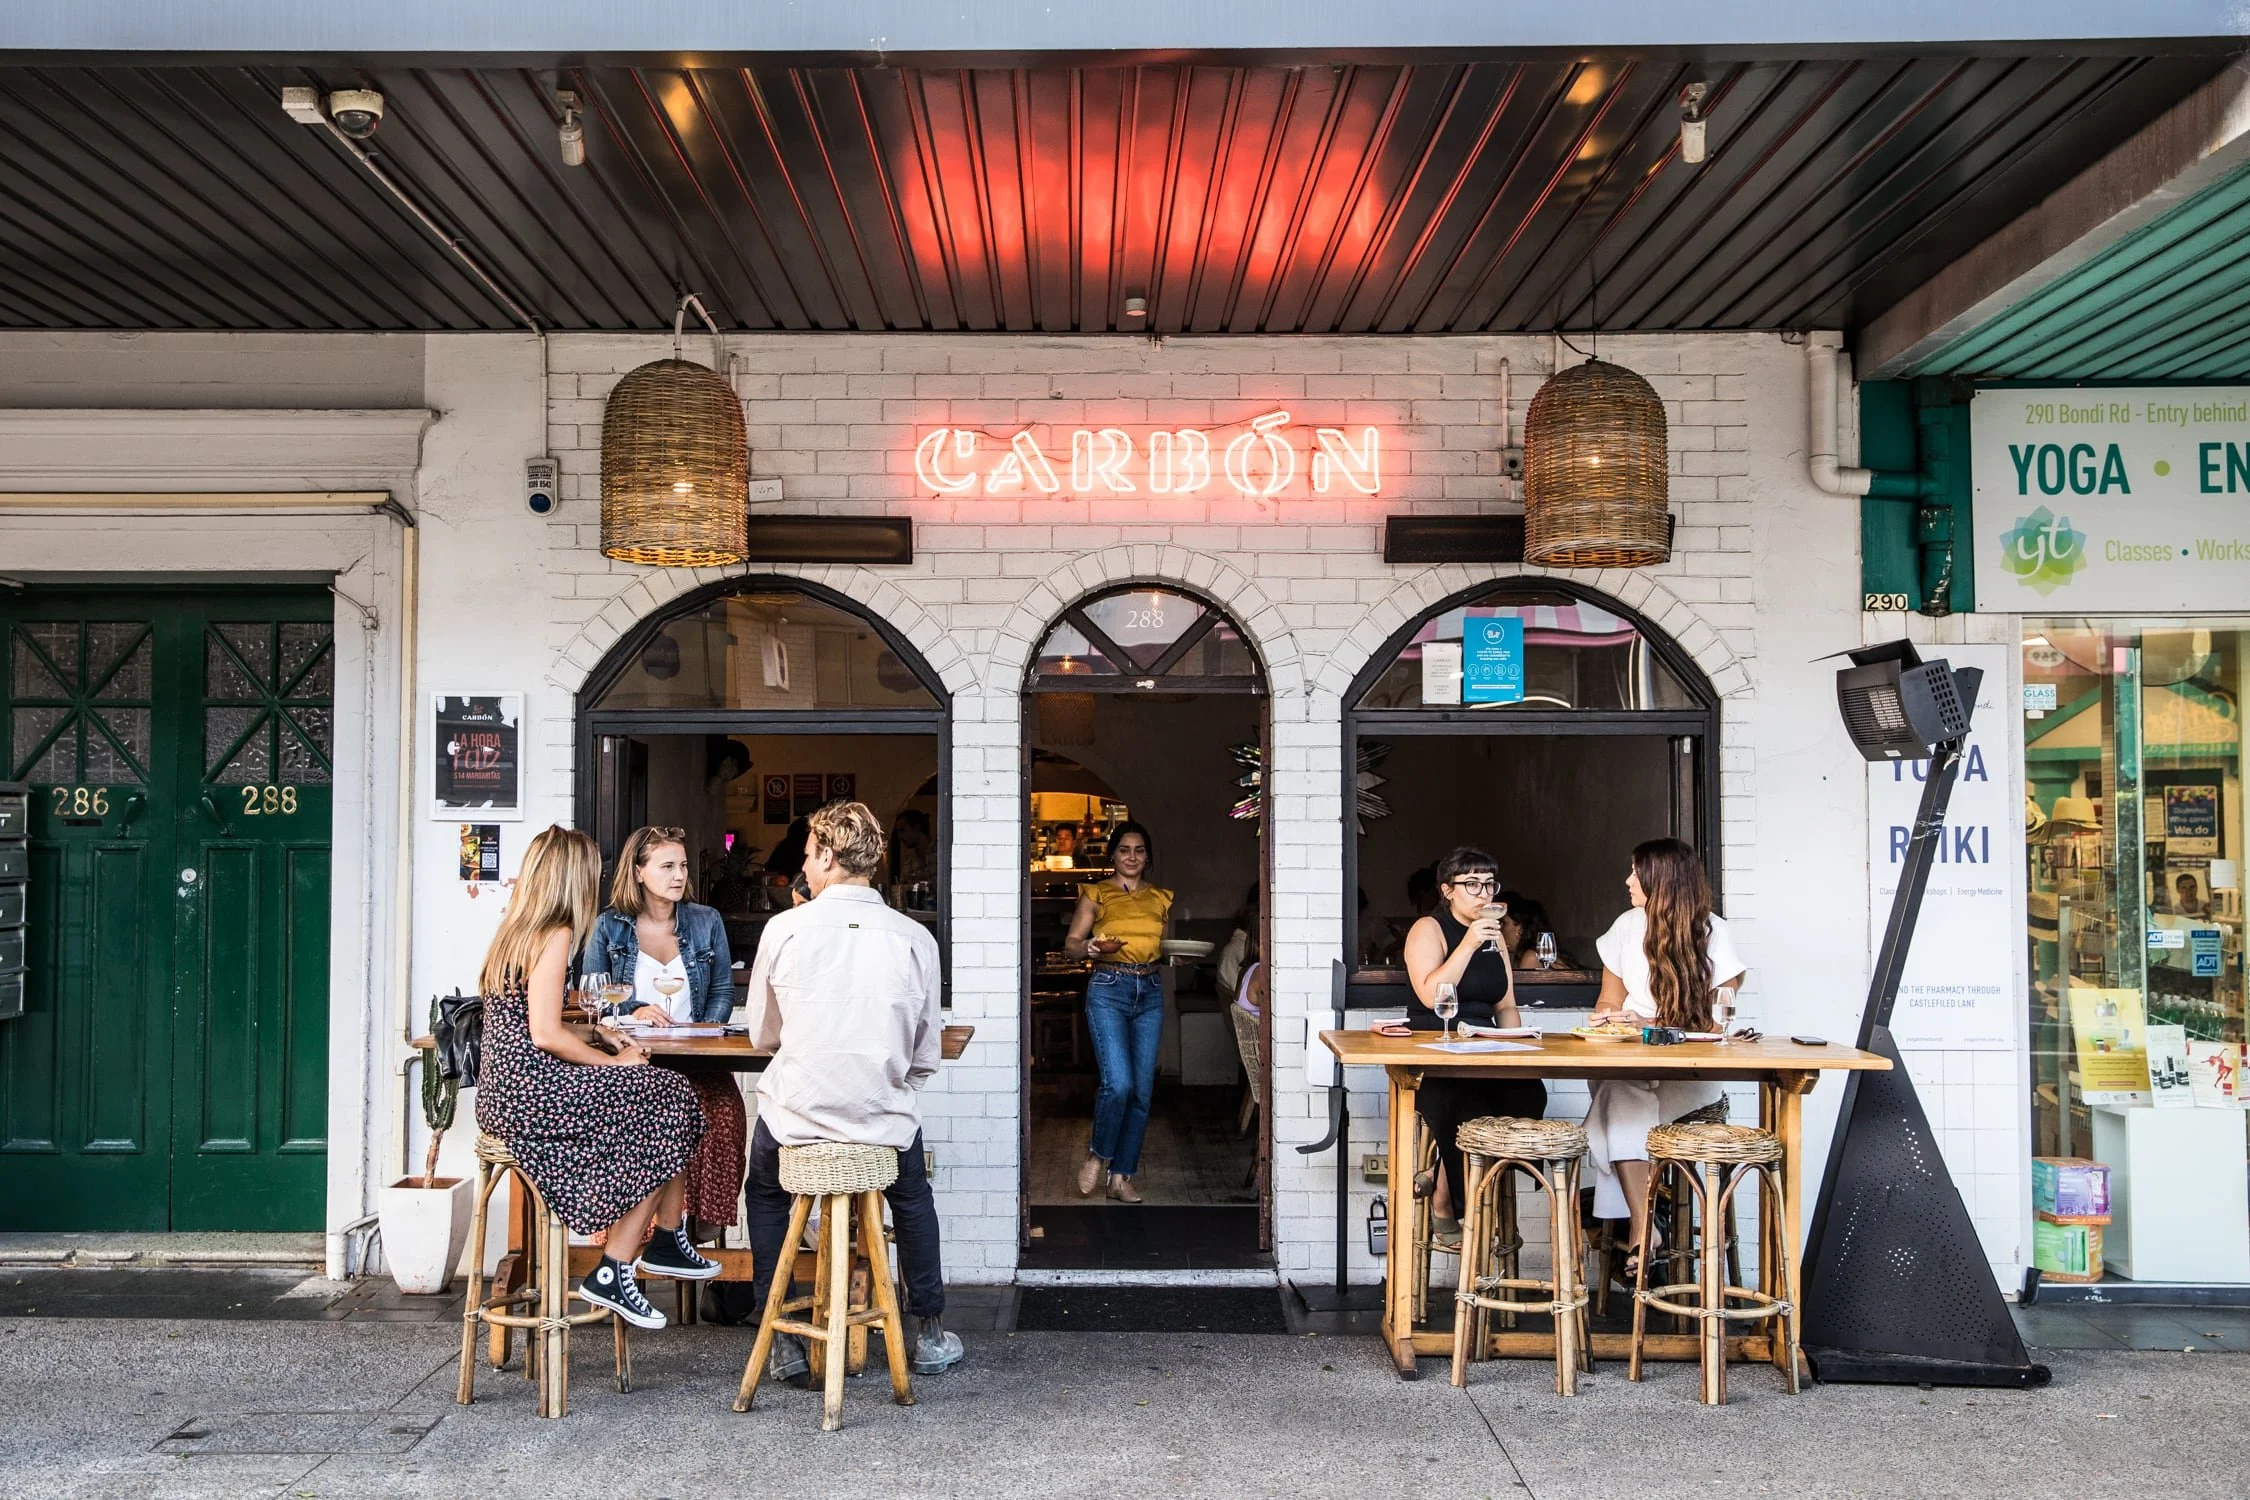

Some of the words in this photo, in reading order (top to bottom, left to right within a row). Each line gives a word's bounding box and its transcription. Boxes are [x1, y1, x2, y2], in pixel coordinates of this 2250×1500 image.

[2026, 403, 2053, 424] 290
[2060, 403, 2103, 424] Bondi
[2110, 403, 2130, 423] Rd
[2148, 402, 2188, 427] Entry
[2193, 401, 2247, 422] behind
[915, 411, 1382, 495] CARBÓN
[2008, 443, 2131, 496] YOGA
[2105, 539, 2172, 562] Classes
[1867, 594, 1906, 610] 290
[1125, 610, 1164, 628] 288
[2023, 689, 2055, 697] GLASS
[462, 713, 493, 721] CARBÓN
[471, 733, 501, 748] HORA
[1892, 745, 1988, 782] YA
[52, 786, 110, 816] 286
[241, 785, 297, 815] 288
[2174, 825, 2192, 835] We
[2195, 825, 2209, 835] do
[1890, 826, 1989, 864] RIKI
[1957, 887, 1976, 897] Energy
[1978, 887, 2003, 896] Medicine
[2148, 933, 2163, 942] ADT
[2197, 956, 2216, 968] ADT
[1911, 986, 1924, 995] THE
[1926, 986, 1965, 995] PHARMACY
[1967, 986, 2001, 995] THROUGH
[1909, 999, 1956, 1008] CASTLEFILED
[1957, 999, 1976, 1008] LANE
